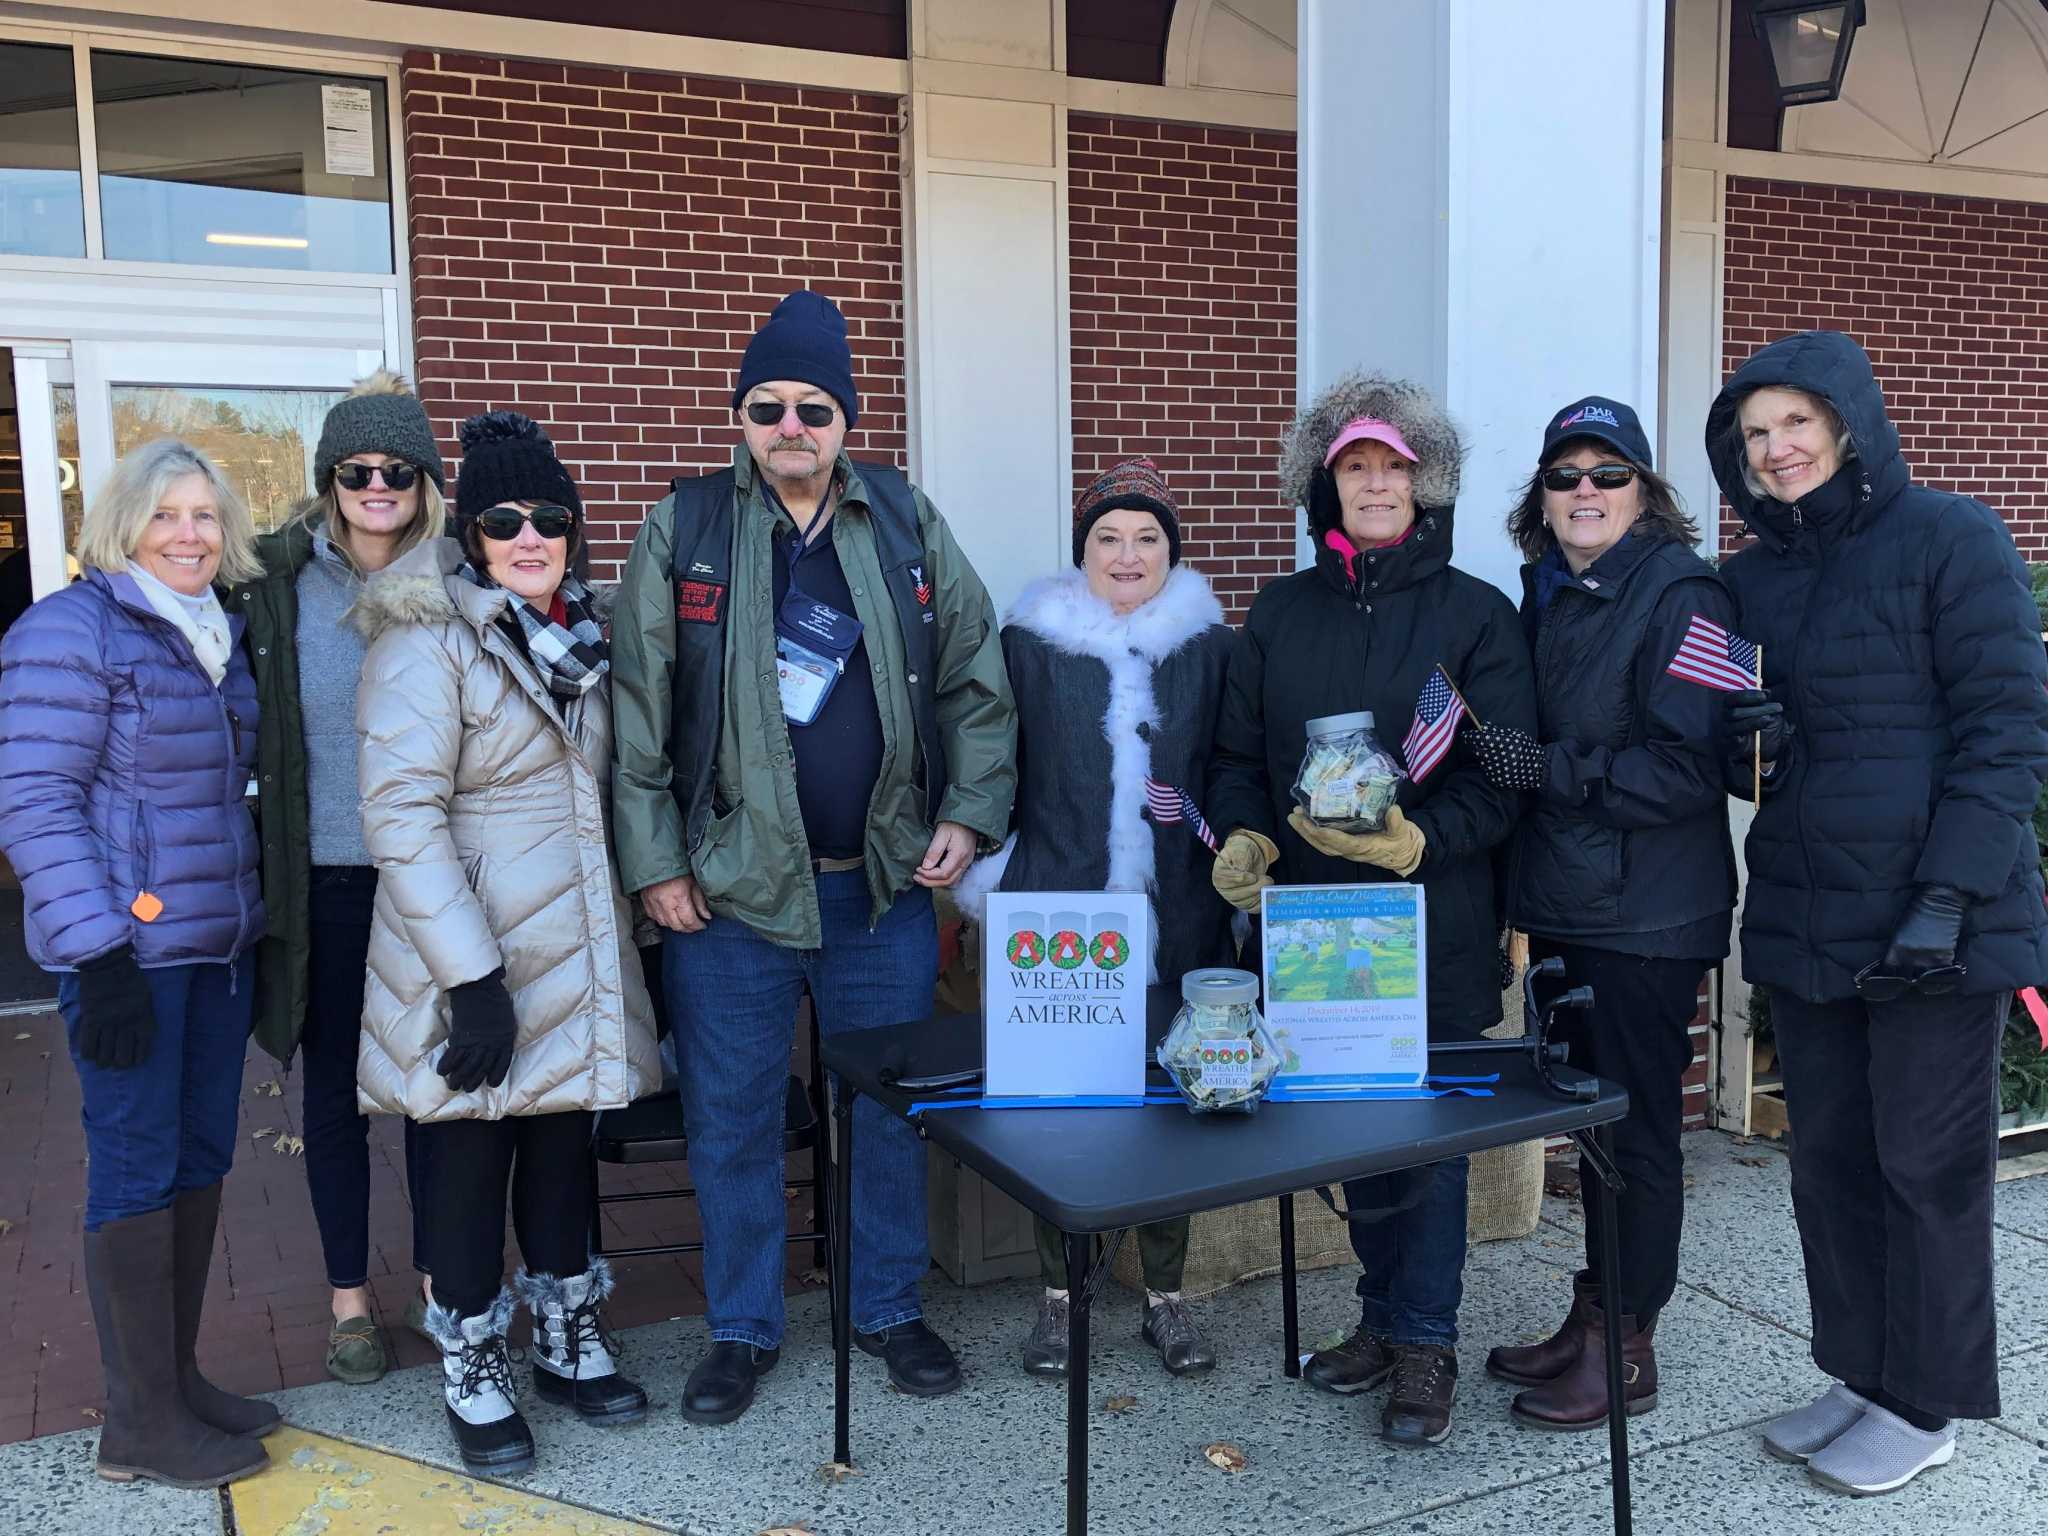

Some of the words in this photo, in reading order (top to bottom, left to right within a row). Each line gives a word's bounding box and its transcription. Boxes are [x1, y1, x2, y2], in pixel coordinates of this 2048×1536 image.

[1584, 406, 1613, 418] DAR
[1333, 906, 1370, 915] HONOR
[1010, 971, 1125, 990] WREATHS
[1048, 992, 1087, 1002] across
[1008, 1004, 1127, 1025] AMERICA
[1203, 1063, 1249, 1073] WREATHS
[1202, 1076, 1249, 1087] AMERICA
